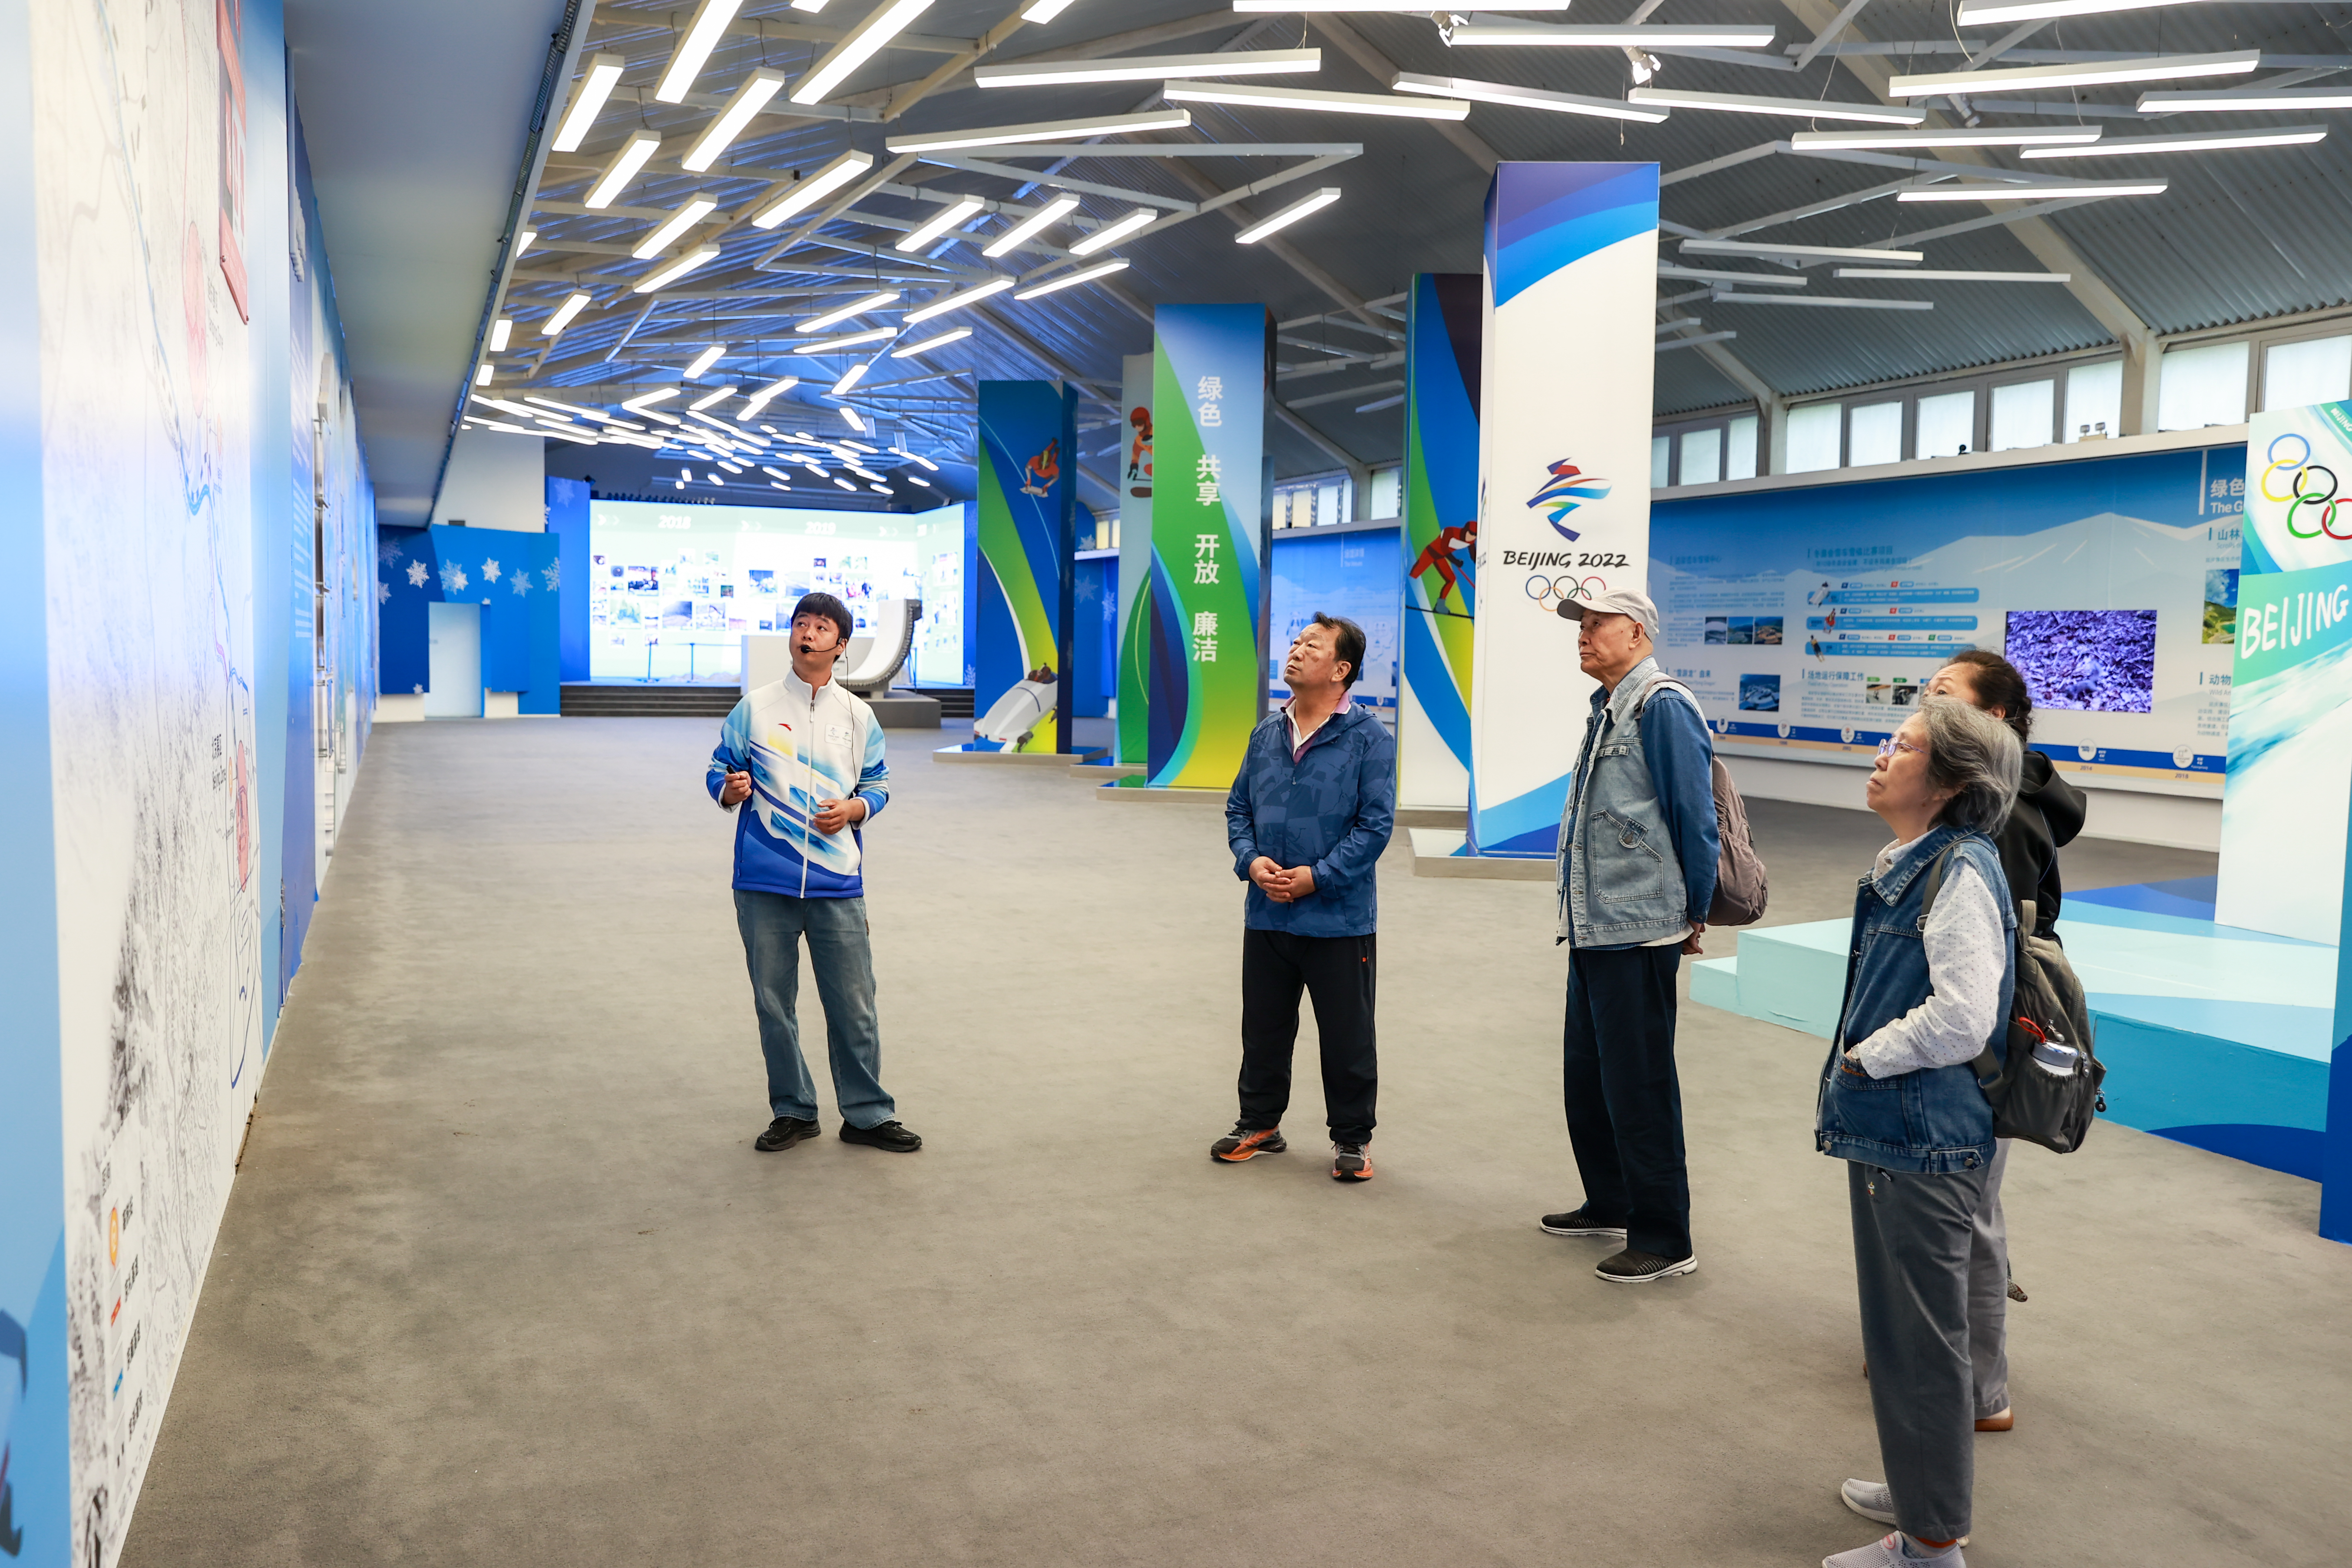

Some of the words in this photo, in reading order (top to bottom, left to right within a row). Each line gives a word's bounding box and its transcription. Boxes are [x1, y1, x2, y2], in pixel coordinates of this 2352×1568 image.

[1198, 376, 1223, 427] 绿色
[2330, 407, 2352, 432] BEIJING
[1196, 455, 1221, 506] 共享
[2210, 477, 2245, 498] 绿色
[2210, 502, 2232, 514] The
[658, 515, 691, 529] 2018
[804, 521, 836, 535] 2019
[2218, 528, 2242, 541] 山林
[1194, 534, 1220, 585] 开放
[1504, 551, 1571, 570] BEIJING
[1578, 553, 1631, 568] 2022
[2241, 585, 2349, 659] BEIJING
[1192, 611, 1218, 662] 廉洁
[1808, 670, 1864, 681] 场地运行保障工作
[2209, 674, 2232, 685] 动物
